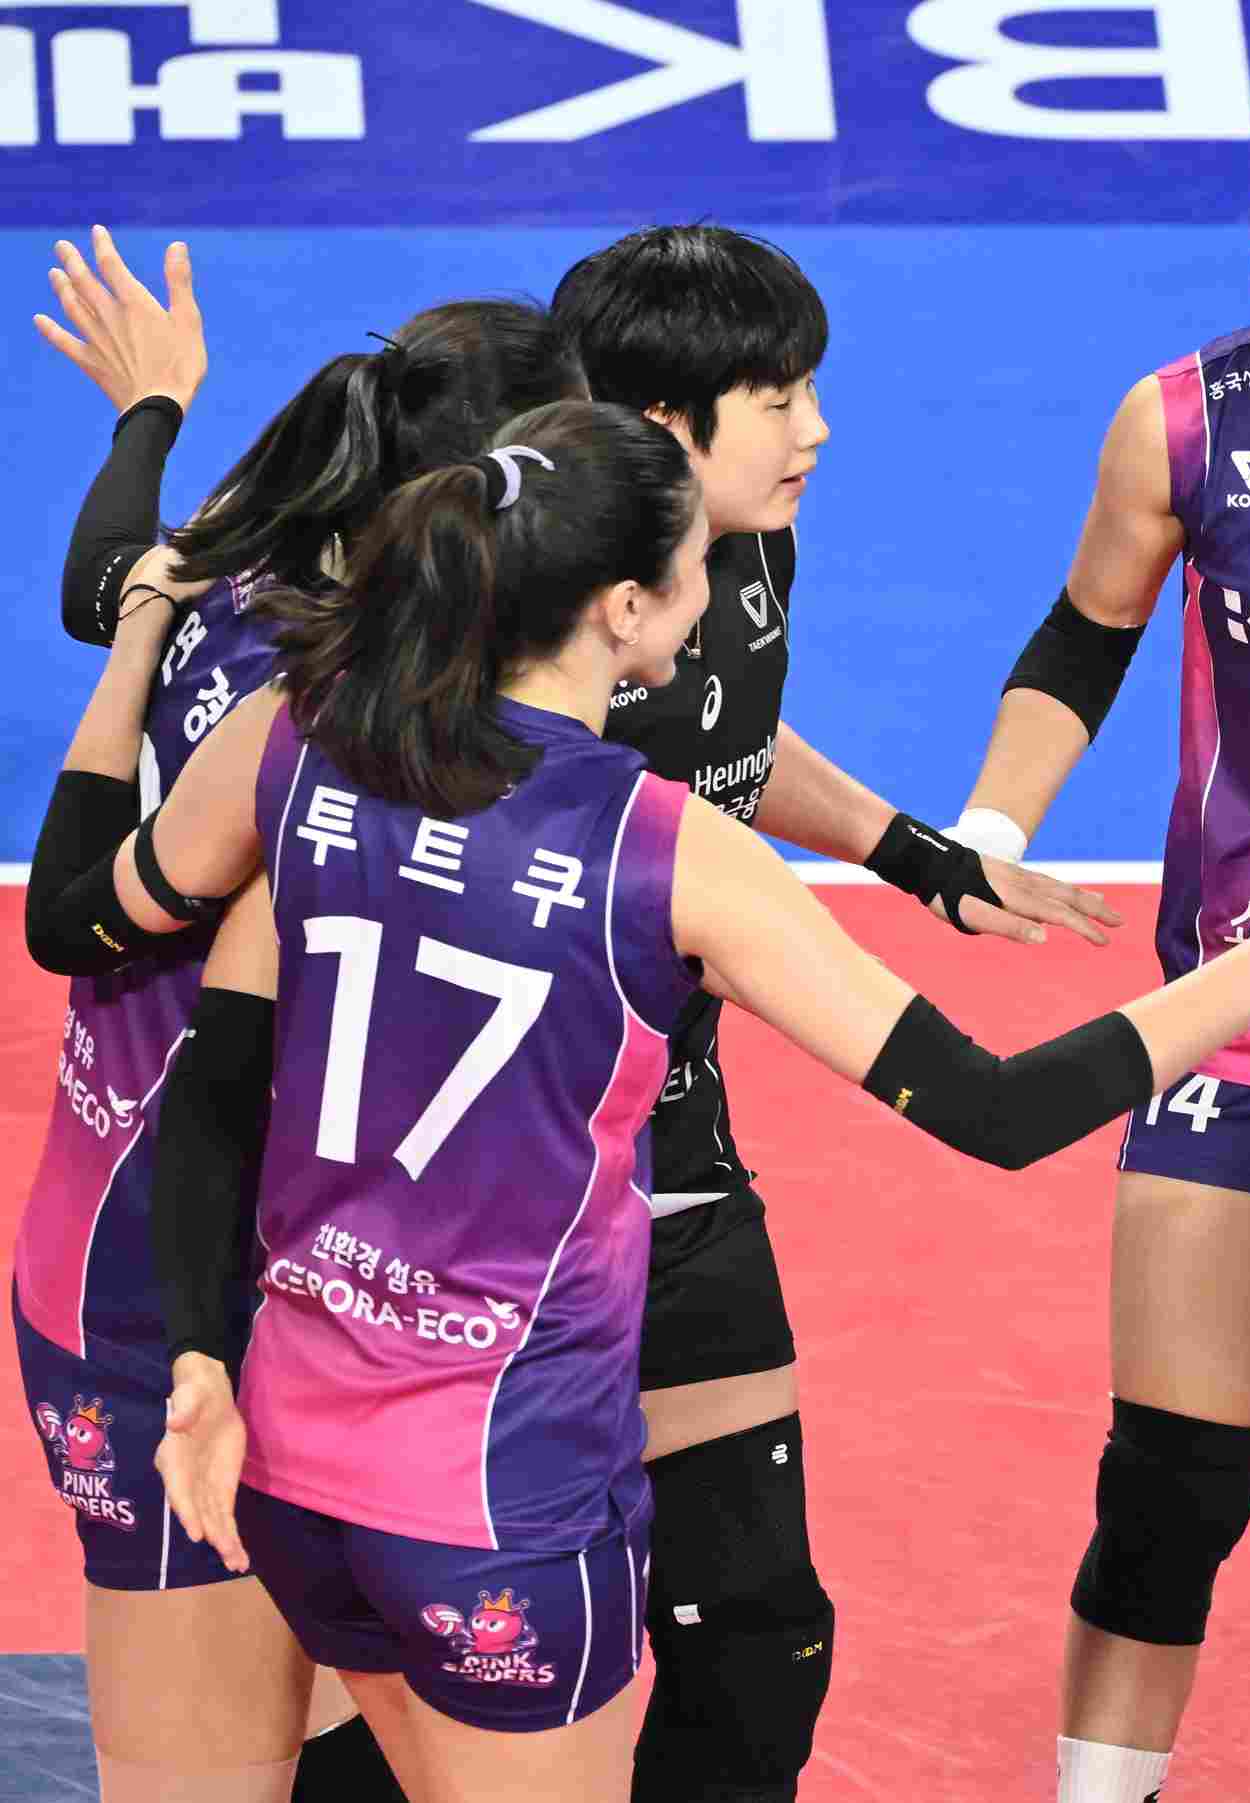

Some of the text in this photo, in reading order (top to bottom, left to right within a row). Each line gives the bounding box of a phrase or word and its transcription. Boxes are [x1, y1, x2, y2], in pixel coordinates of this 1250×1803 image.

[609, 686, 649, 710] KOVO
[693, 735, 776, 797] Heungk
[296, 784, 587, 929] 투트쿠
[302, 914, 555, 1183] 17
[1145, 1073, 1222, 1133] 14
[264, 1258, 498, 1350] CEPORA-ECO
[385, 1257, 441, 1296] 섬유
[62, 1470, 111, 1500] PINK
